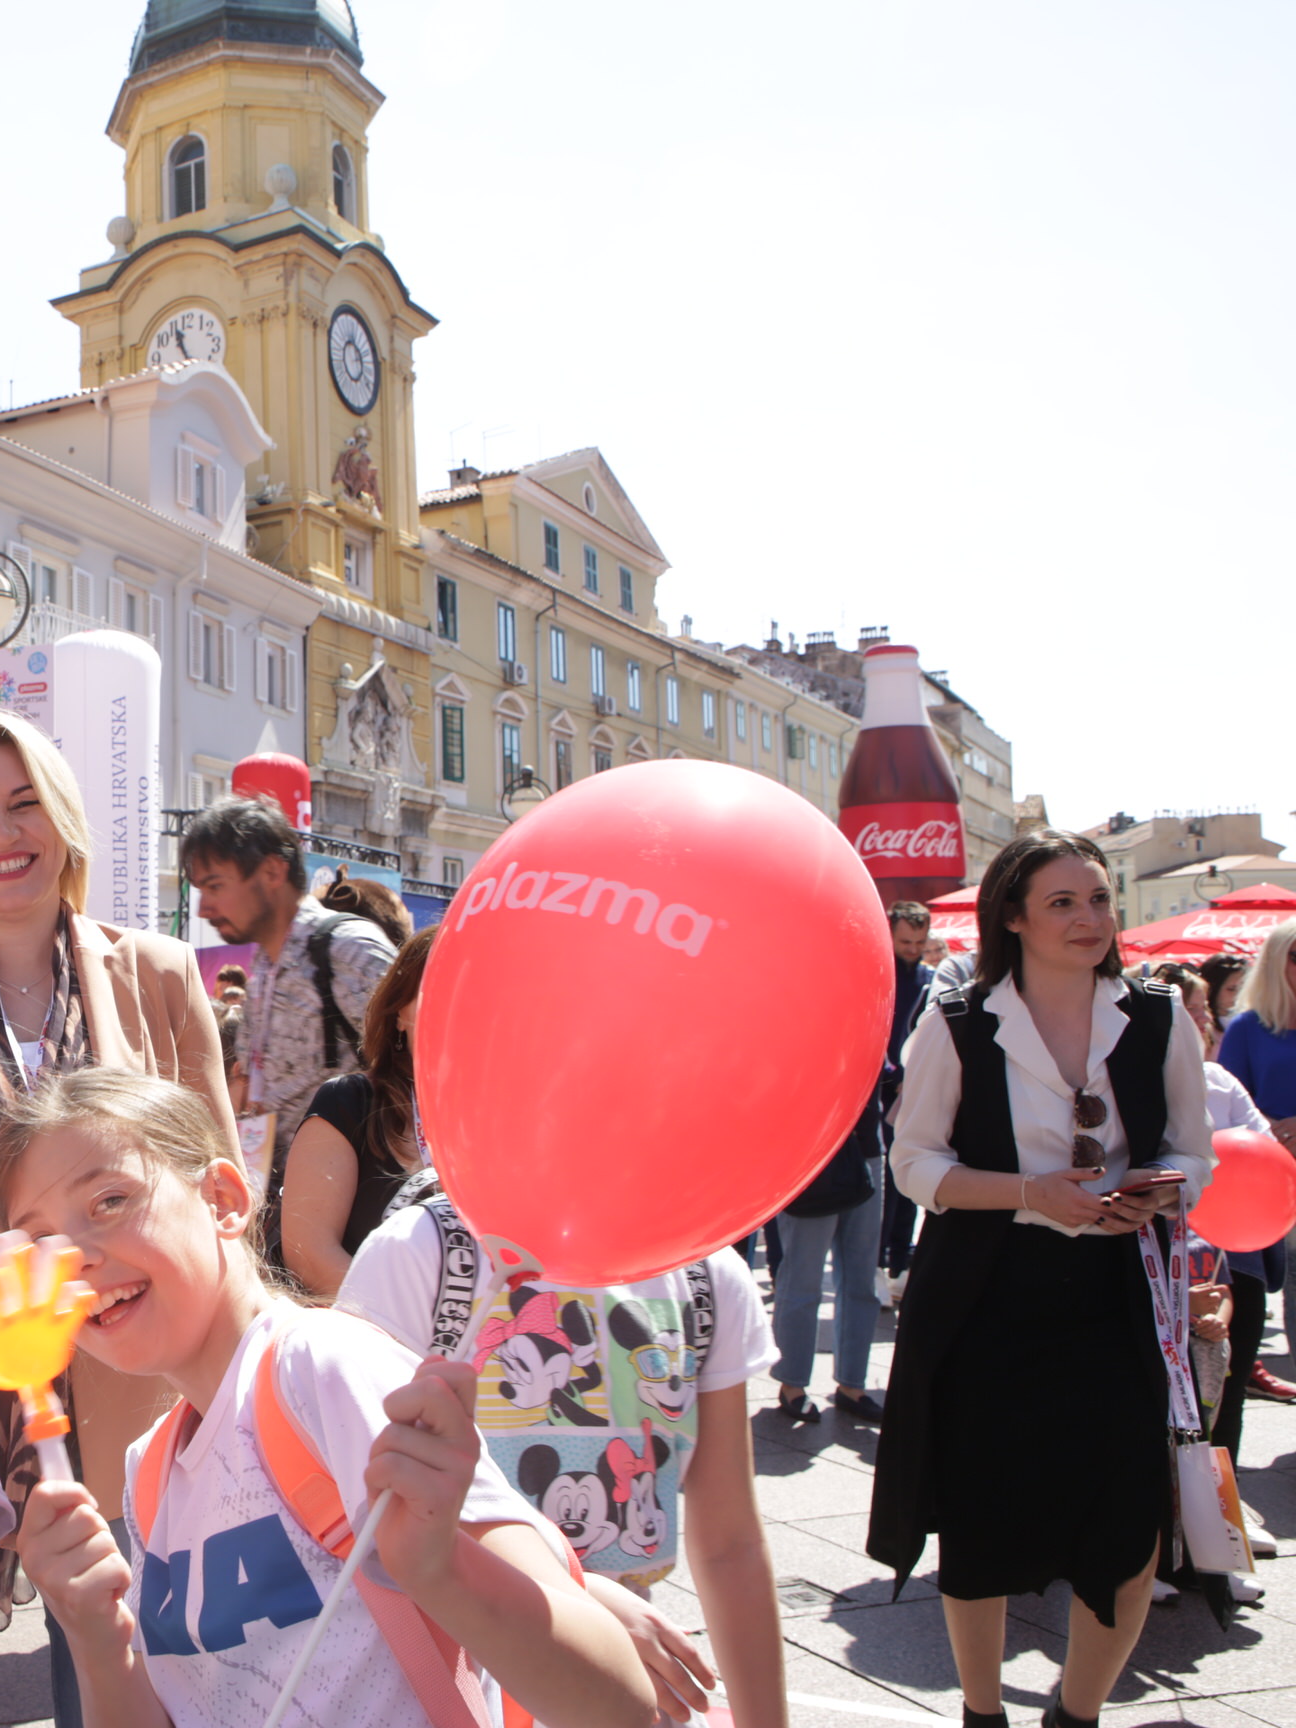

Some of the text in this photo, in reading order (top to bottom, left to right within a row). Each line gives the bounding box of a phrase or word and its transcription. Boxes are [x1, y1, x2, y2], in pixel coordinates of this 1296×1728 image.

[111, 696, 127, 805] HRVATSKA
[855, 820, 959, 860] Coca-Cola
[455, 861, 713, 957] plazma
